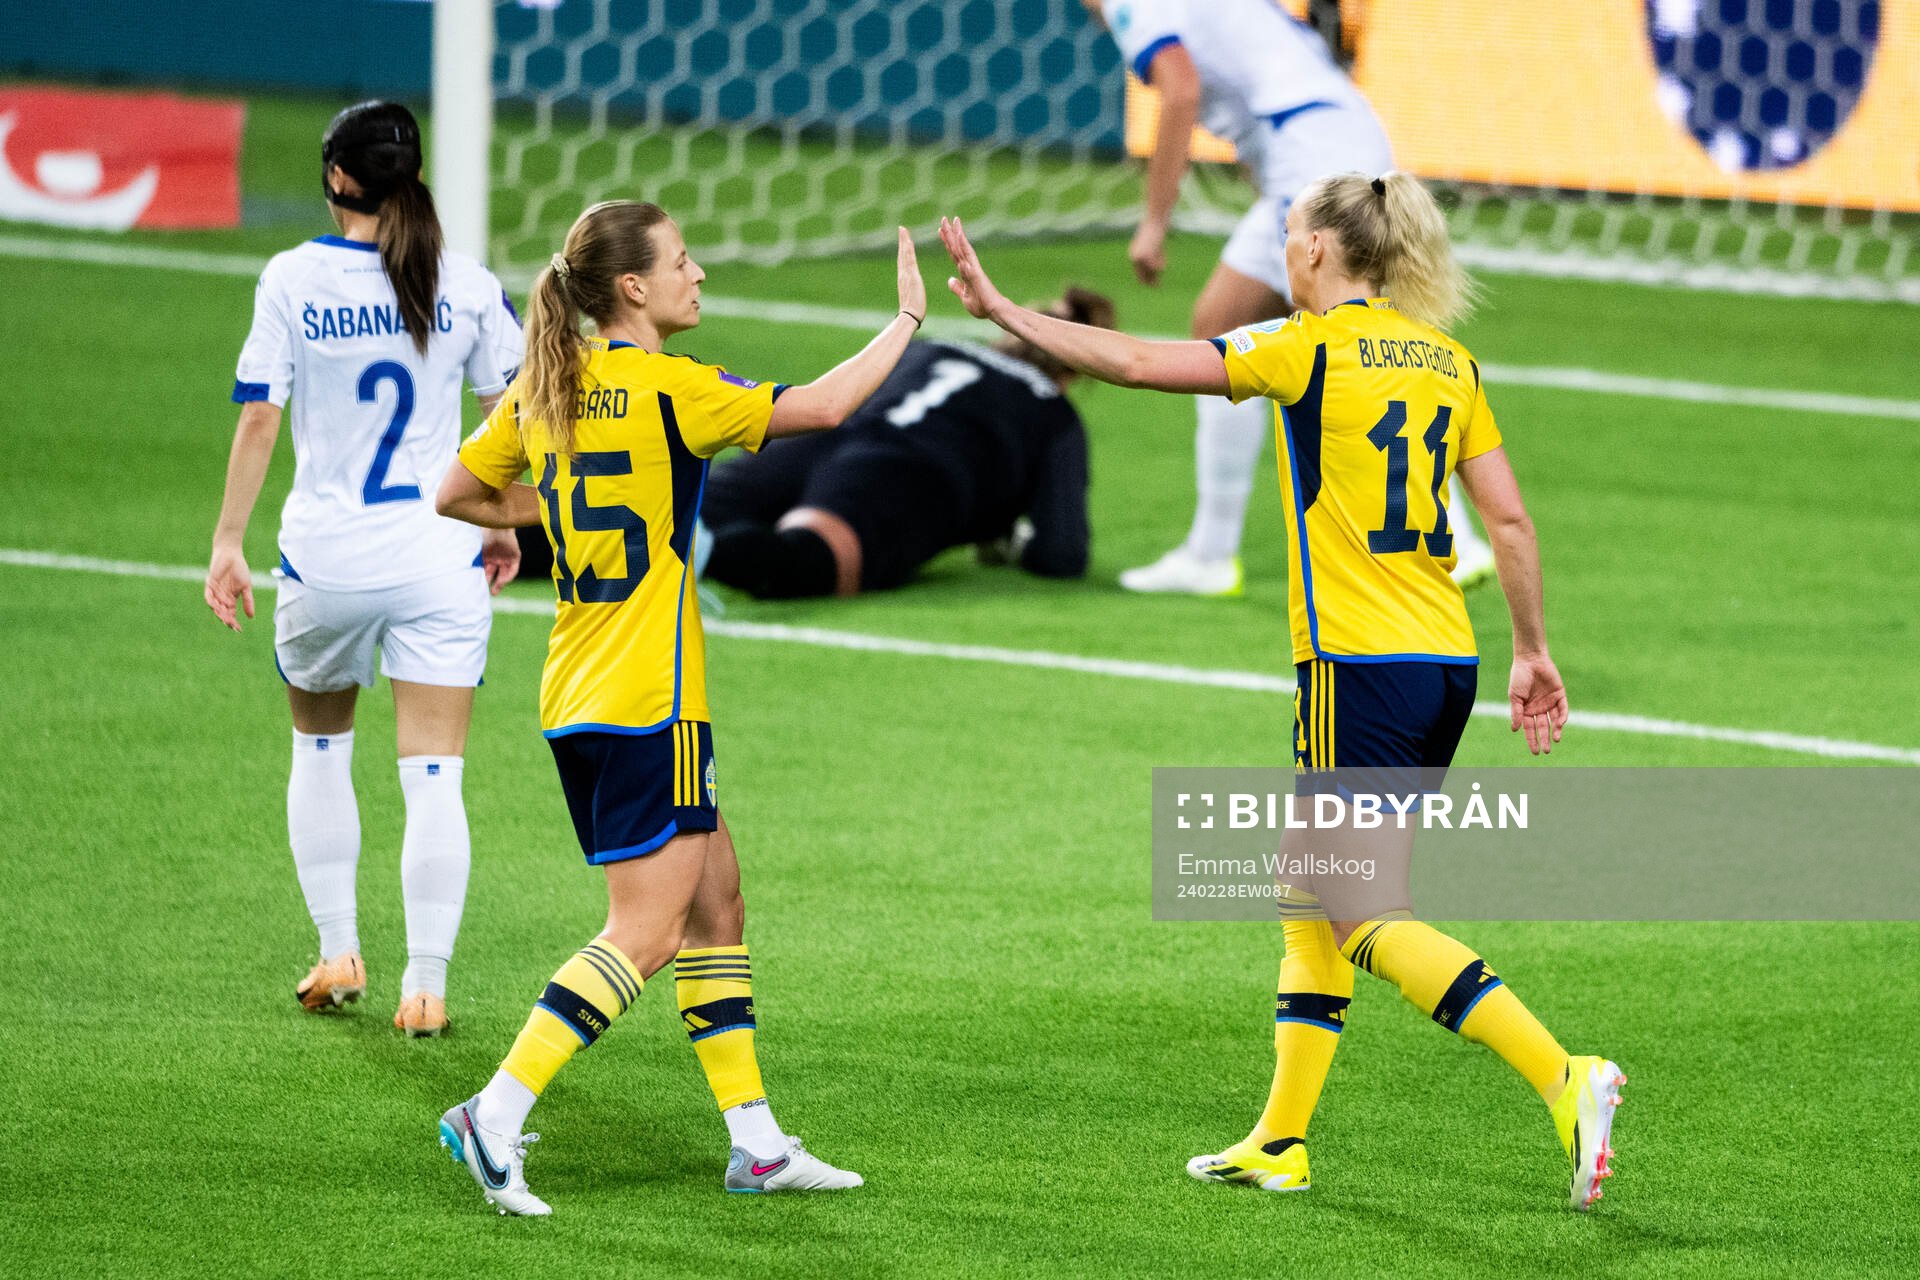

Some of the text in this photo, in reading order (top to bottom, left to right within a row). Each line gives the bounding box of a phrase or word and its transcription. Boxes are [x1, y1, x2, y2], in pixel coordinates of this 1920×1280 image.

[303, 295, 452, 341] ŠABANAĆ
[1358, 338, 1458, 379] BLACKSTENIUS
[356, 359, 425, 509] 2
[1366, 400, 1454, 558] 11
[537, 450, 651, 605] 15
